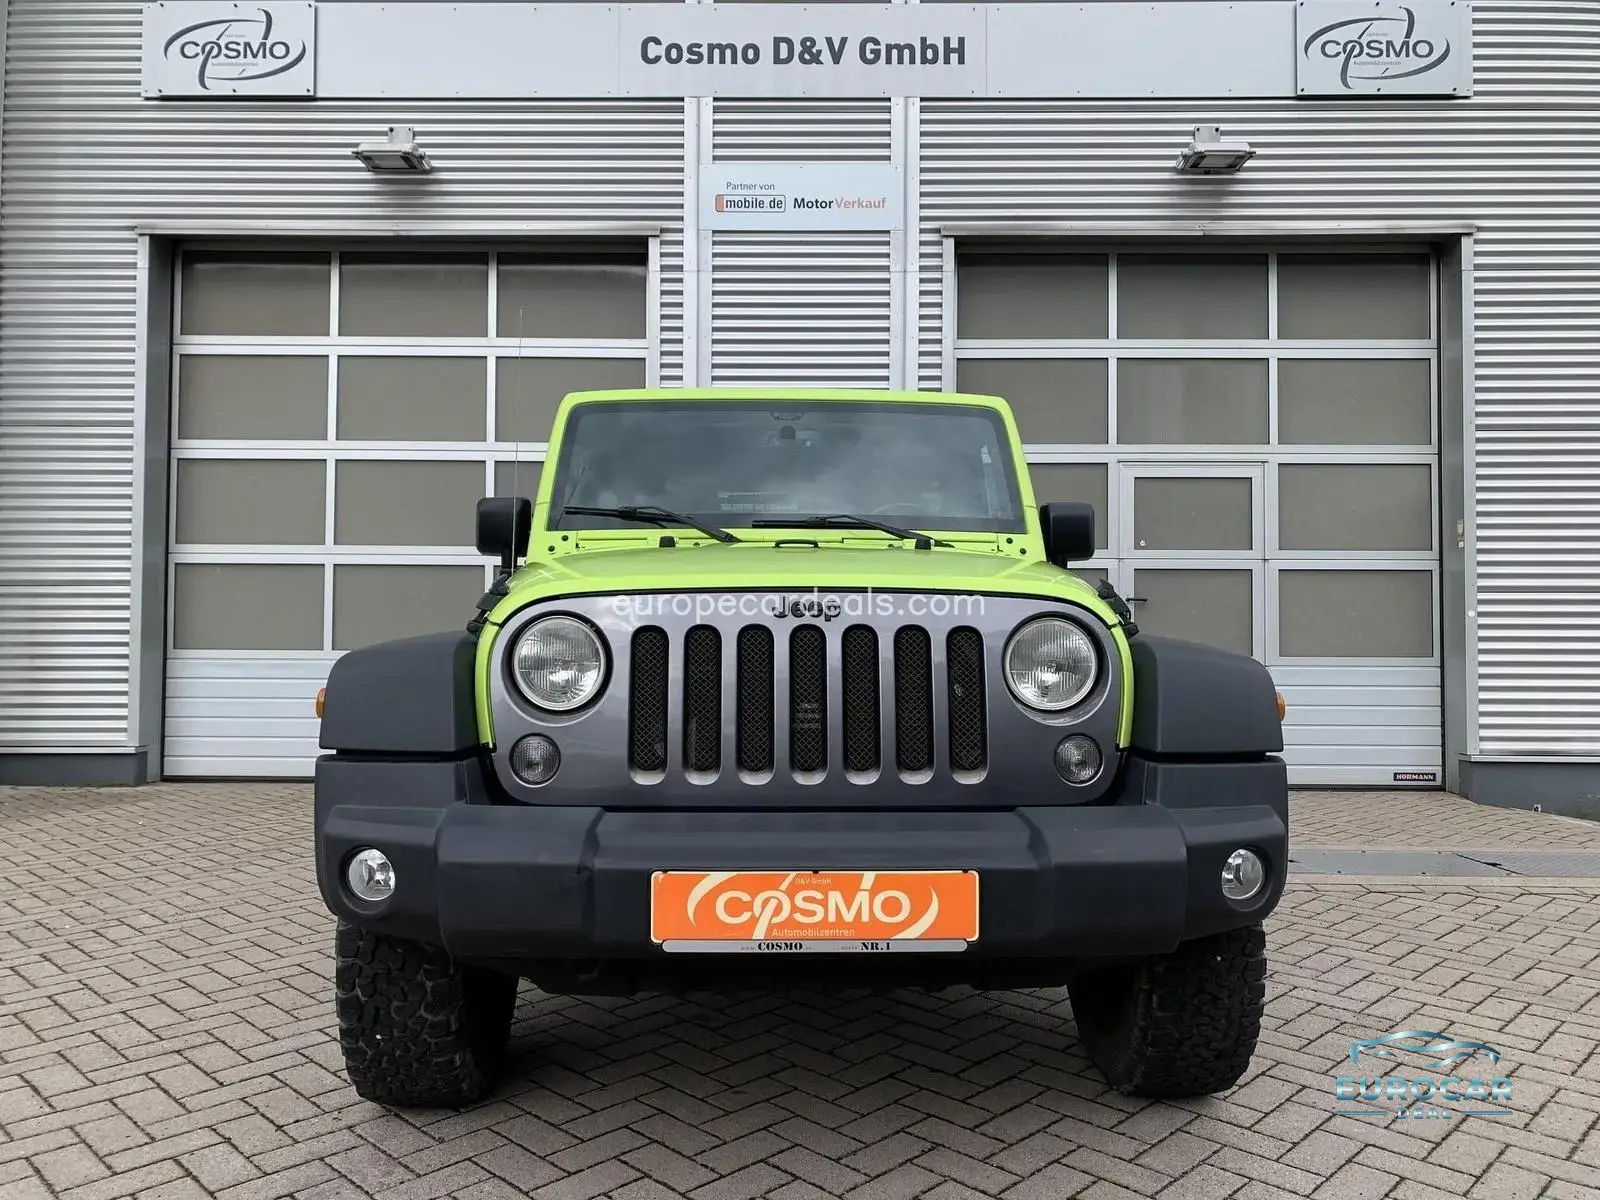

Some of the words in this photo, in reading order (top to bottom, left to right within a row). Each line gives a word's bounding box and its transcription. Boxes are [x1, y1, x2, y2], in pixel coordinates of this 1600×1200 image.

[179, 40, 290, 59] COSMO
[640, 36, 761, 65] Cosmo
[772, 36, 848, 65] D&V
[858, 36, 966, 65] GmbH
[1320, 39, 1434, 58] COSMO
[726, 181, 757, 190] Partner
[725, 197, 783, 209] mobile.de
[772, 595, 841, 622] Jeep
[715, 888, 911, 924] COSMO
[771, 927, 855, 937] Automobilzentren
[757, 941, 803, 951] COSMO
